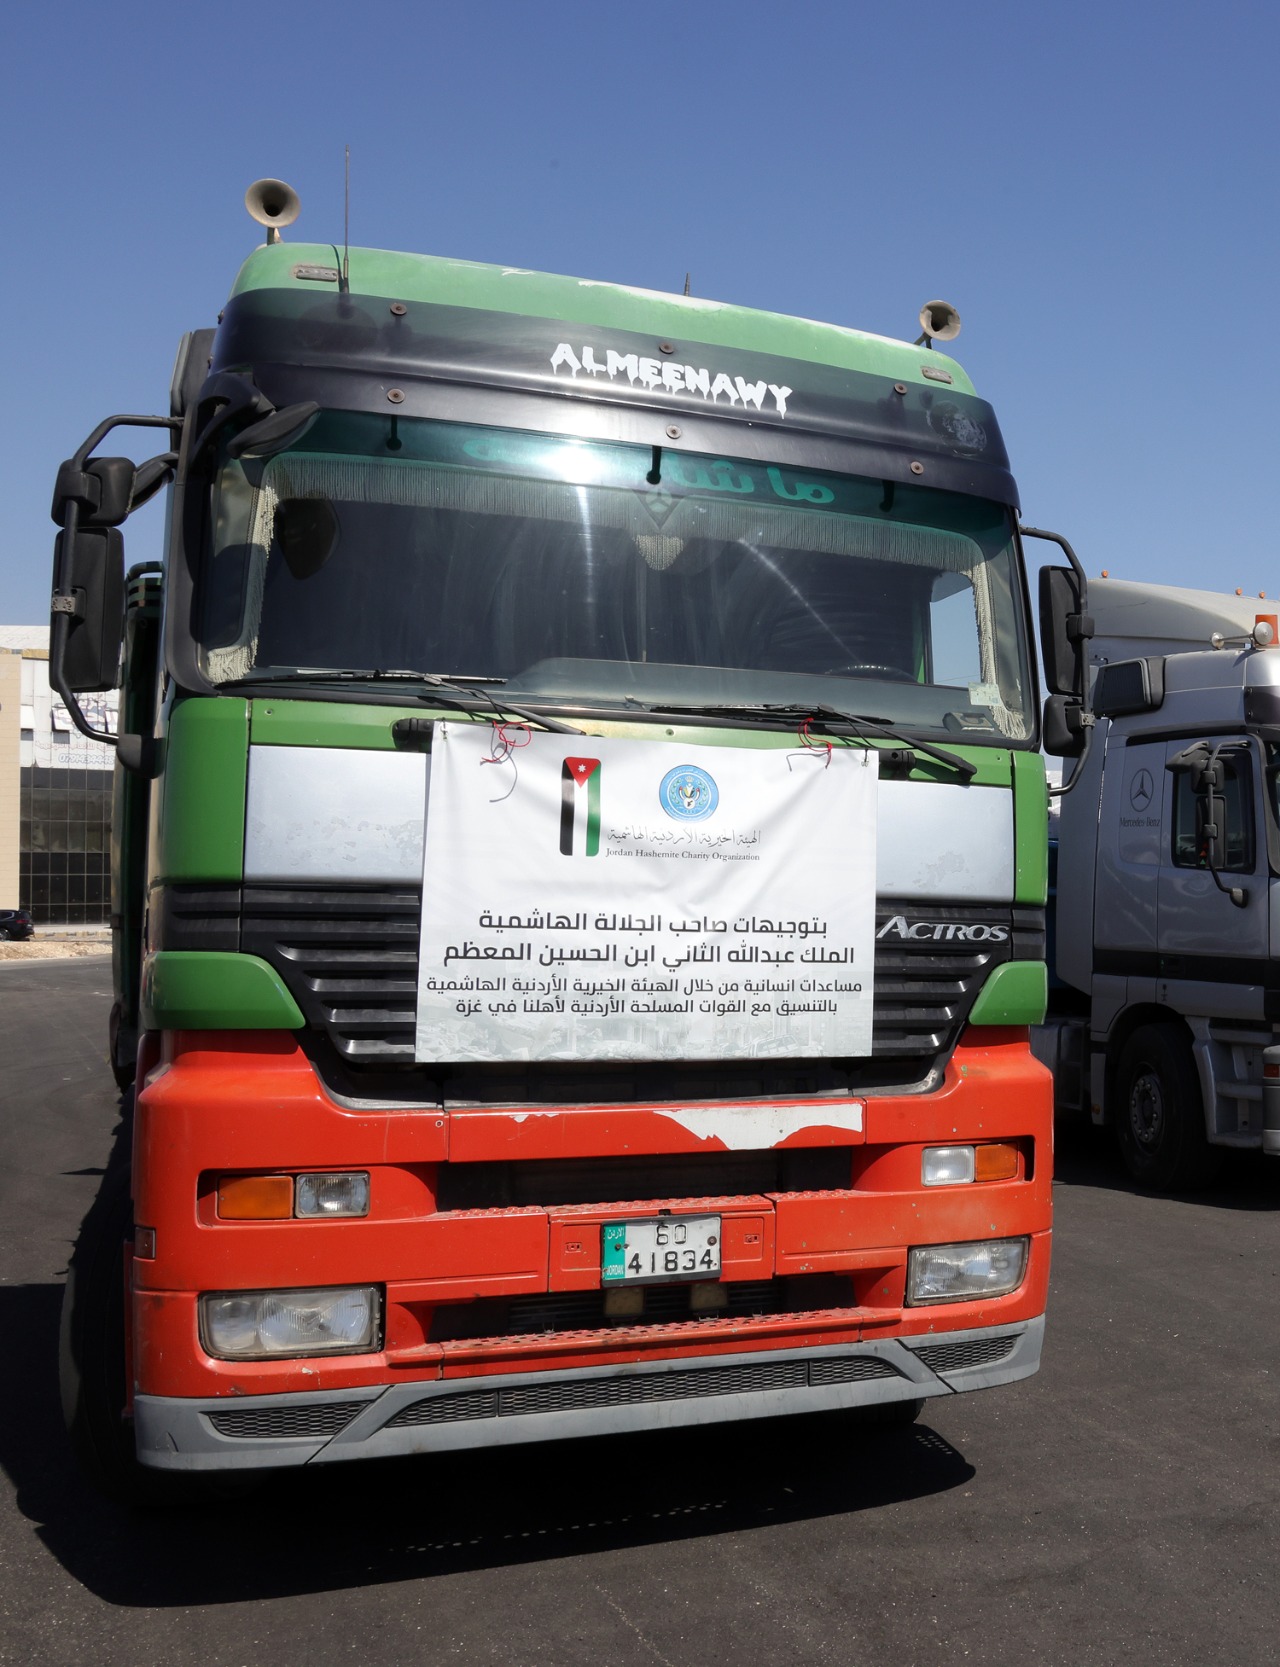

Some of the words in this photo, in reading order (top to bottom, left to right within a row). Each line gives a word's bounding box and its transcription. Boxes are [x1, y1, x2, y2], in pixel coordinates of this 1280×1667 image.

[550, 343, 793, 419] ALMEENAWY
[605, 848, 633, 858] Jordan
[635, 849, 680, 859] Hashemite
[681, 850, 711, 861] Charity
[712, 852, 760, 862] Organization
[479, 908, 588, 934] الهاشمية
[594, 913, 662, 936] الجلالة
[669, 917, 728, 937] صاحب
[733, 917, 827, 939] بتوجيهات
[443, 941, 532, 967] المعظم
[538, 944, 617, 966] الحسين
[624, 945, 656, 967] ابن
[662, 942, 721, 972] الثاني
[727, 940, 795, 968] عبدالله
[799, 947, 855, 964] الملك
[426, 975, 506, 994] الهاشمية
[512, 974, 567, 995] الأردنية
[572, 978, 626, 996] الخيرية
[631, 978, 679, 995] الهيئة
[683, 979, 714, 995] خلال
[718, 980, 739, 995] من
[800, 979, 862, 992] مساعدات
[455, 999, 482, 1017] غزة
[488, 1000, 517, 1016] في
[523, 995, 565, 1013] لأهلنا
[570, 995, 625, 1017] الأردنية
[630, 999, 694, 1013] المسلحة
[699, 1000, 746, 1017] القوات
[750, 1003, 771, 1016] مع
[776, 1000, 837, 1017] بالتنسيق
[605, 1264, 624, 1276] JORDAN
[628, 1249, 714, 1274] 41834
